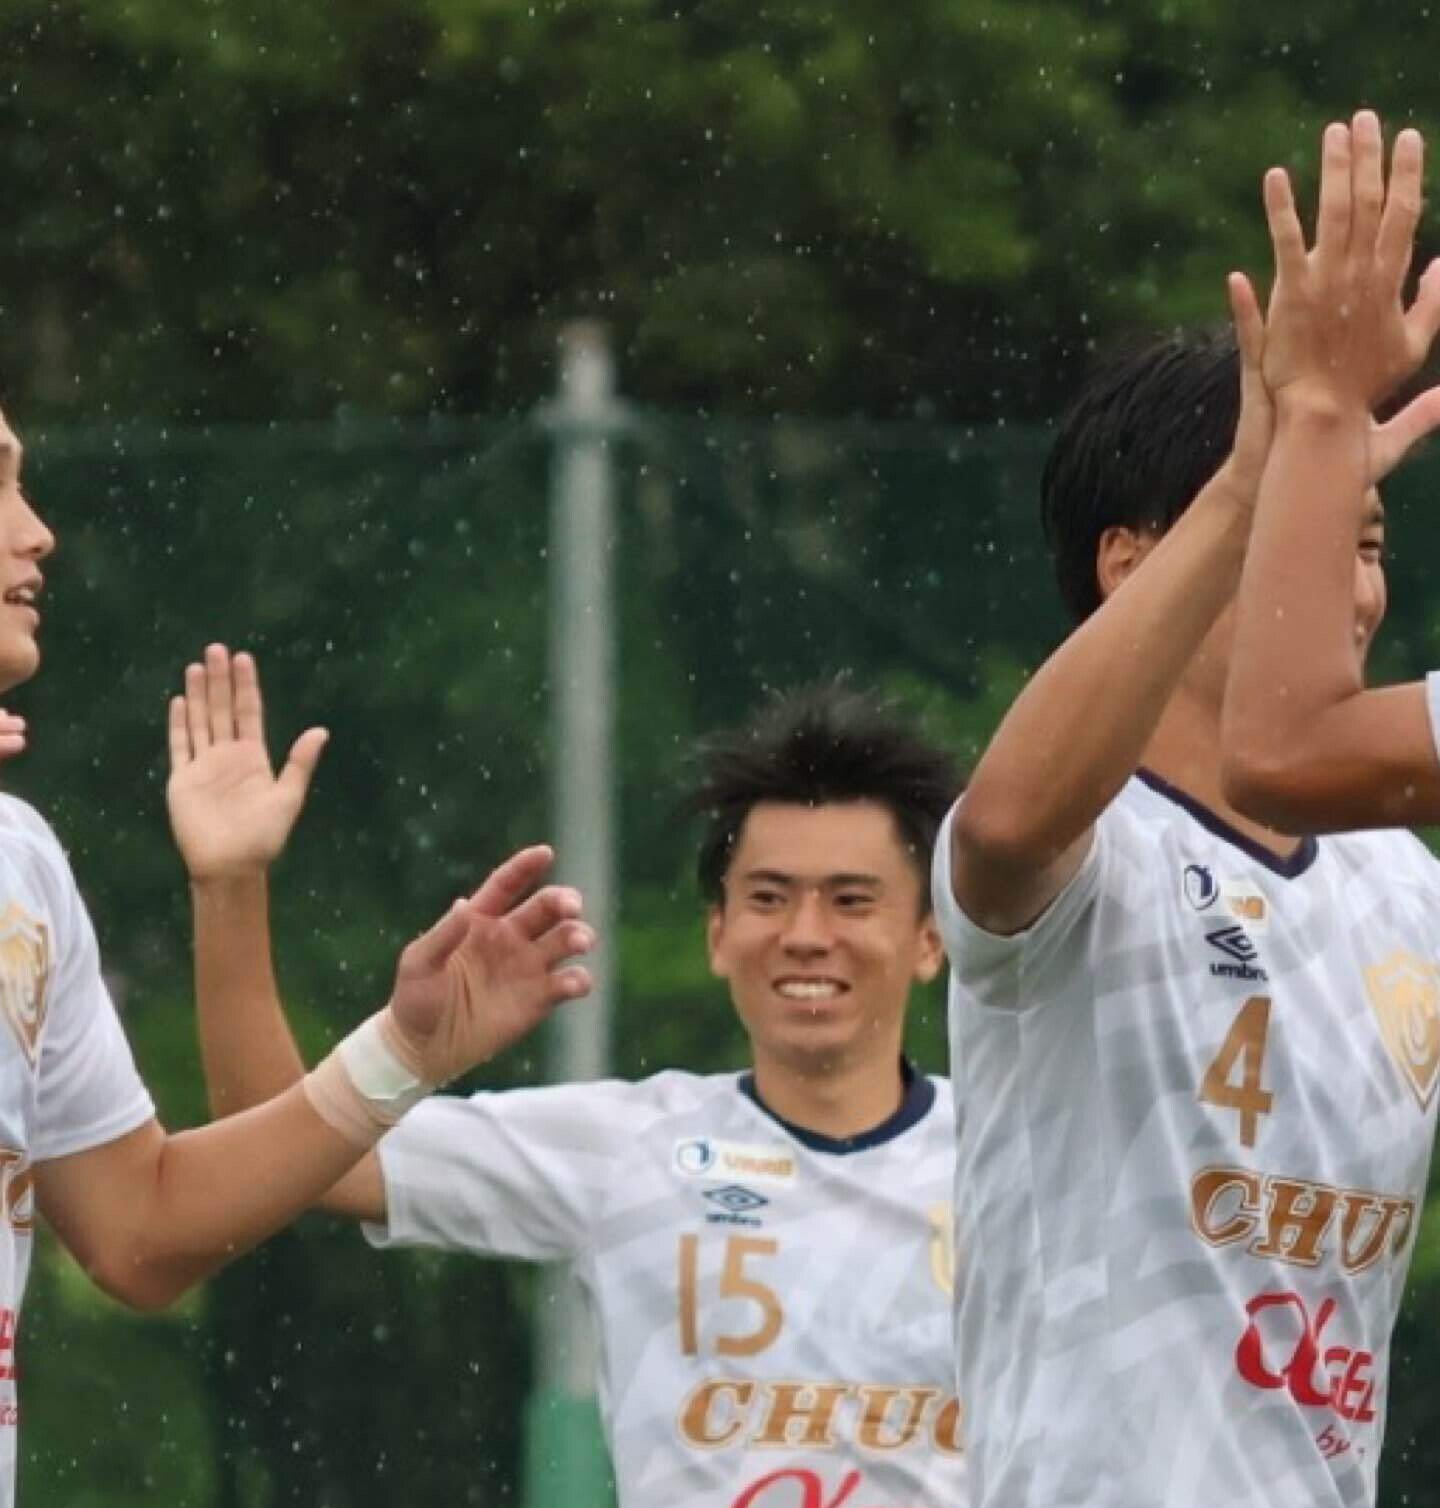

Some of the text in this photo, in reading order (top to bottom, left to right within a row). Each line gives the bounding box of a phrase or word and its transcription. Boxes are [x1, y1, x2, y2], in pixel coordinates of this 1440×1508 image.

[1199, 995, 1274, 1148] 4
[1192, 1168, 1413, 1276] CHU
[679, 1233, 784, 1357] 15
